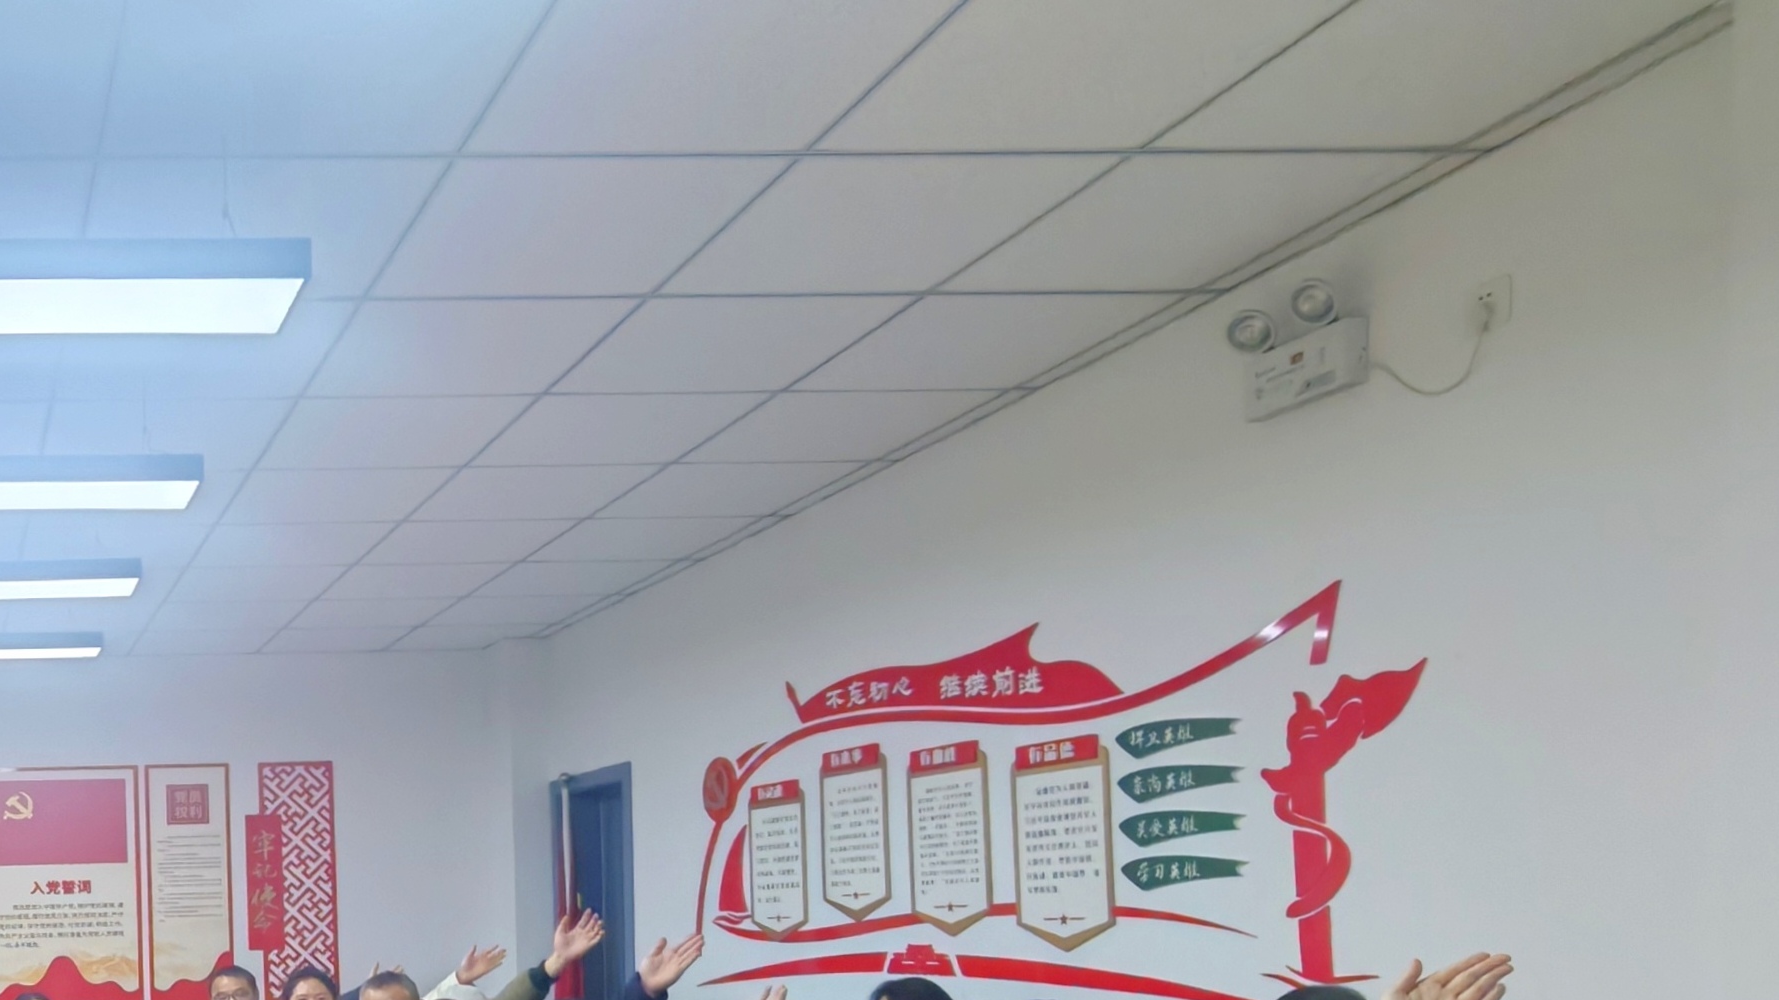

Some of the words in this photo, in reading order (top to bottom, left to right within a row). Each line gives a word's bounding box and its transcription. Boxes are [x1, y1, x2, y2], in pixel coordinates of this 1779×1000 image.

[825, 676, 914, 708] 不忘初心
[939, 666, 1044, 699] 继续前进
[1129, 723, 1194, 748] 捍卫英雄
[250, 829, 280, 934] 牢记使命
[1137, 860, 1200, 883] 学习英雄
[30, 880, 92, 895] 入党誓词
